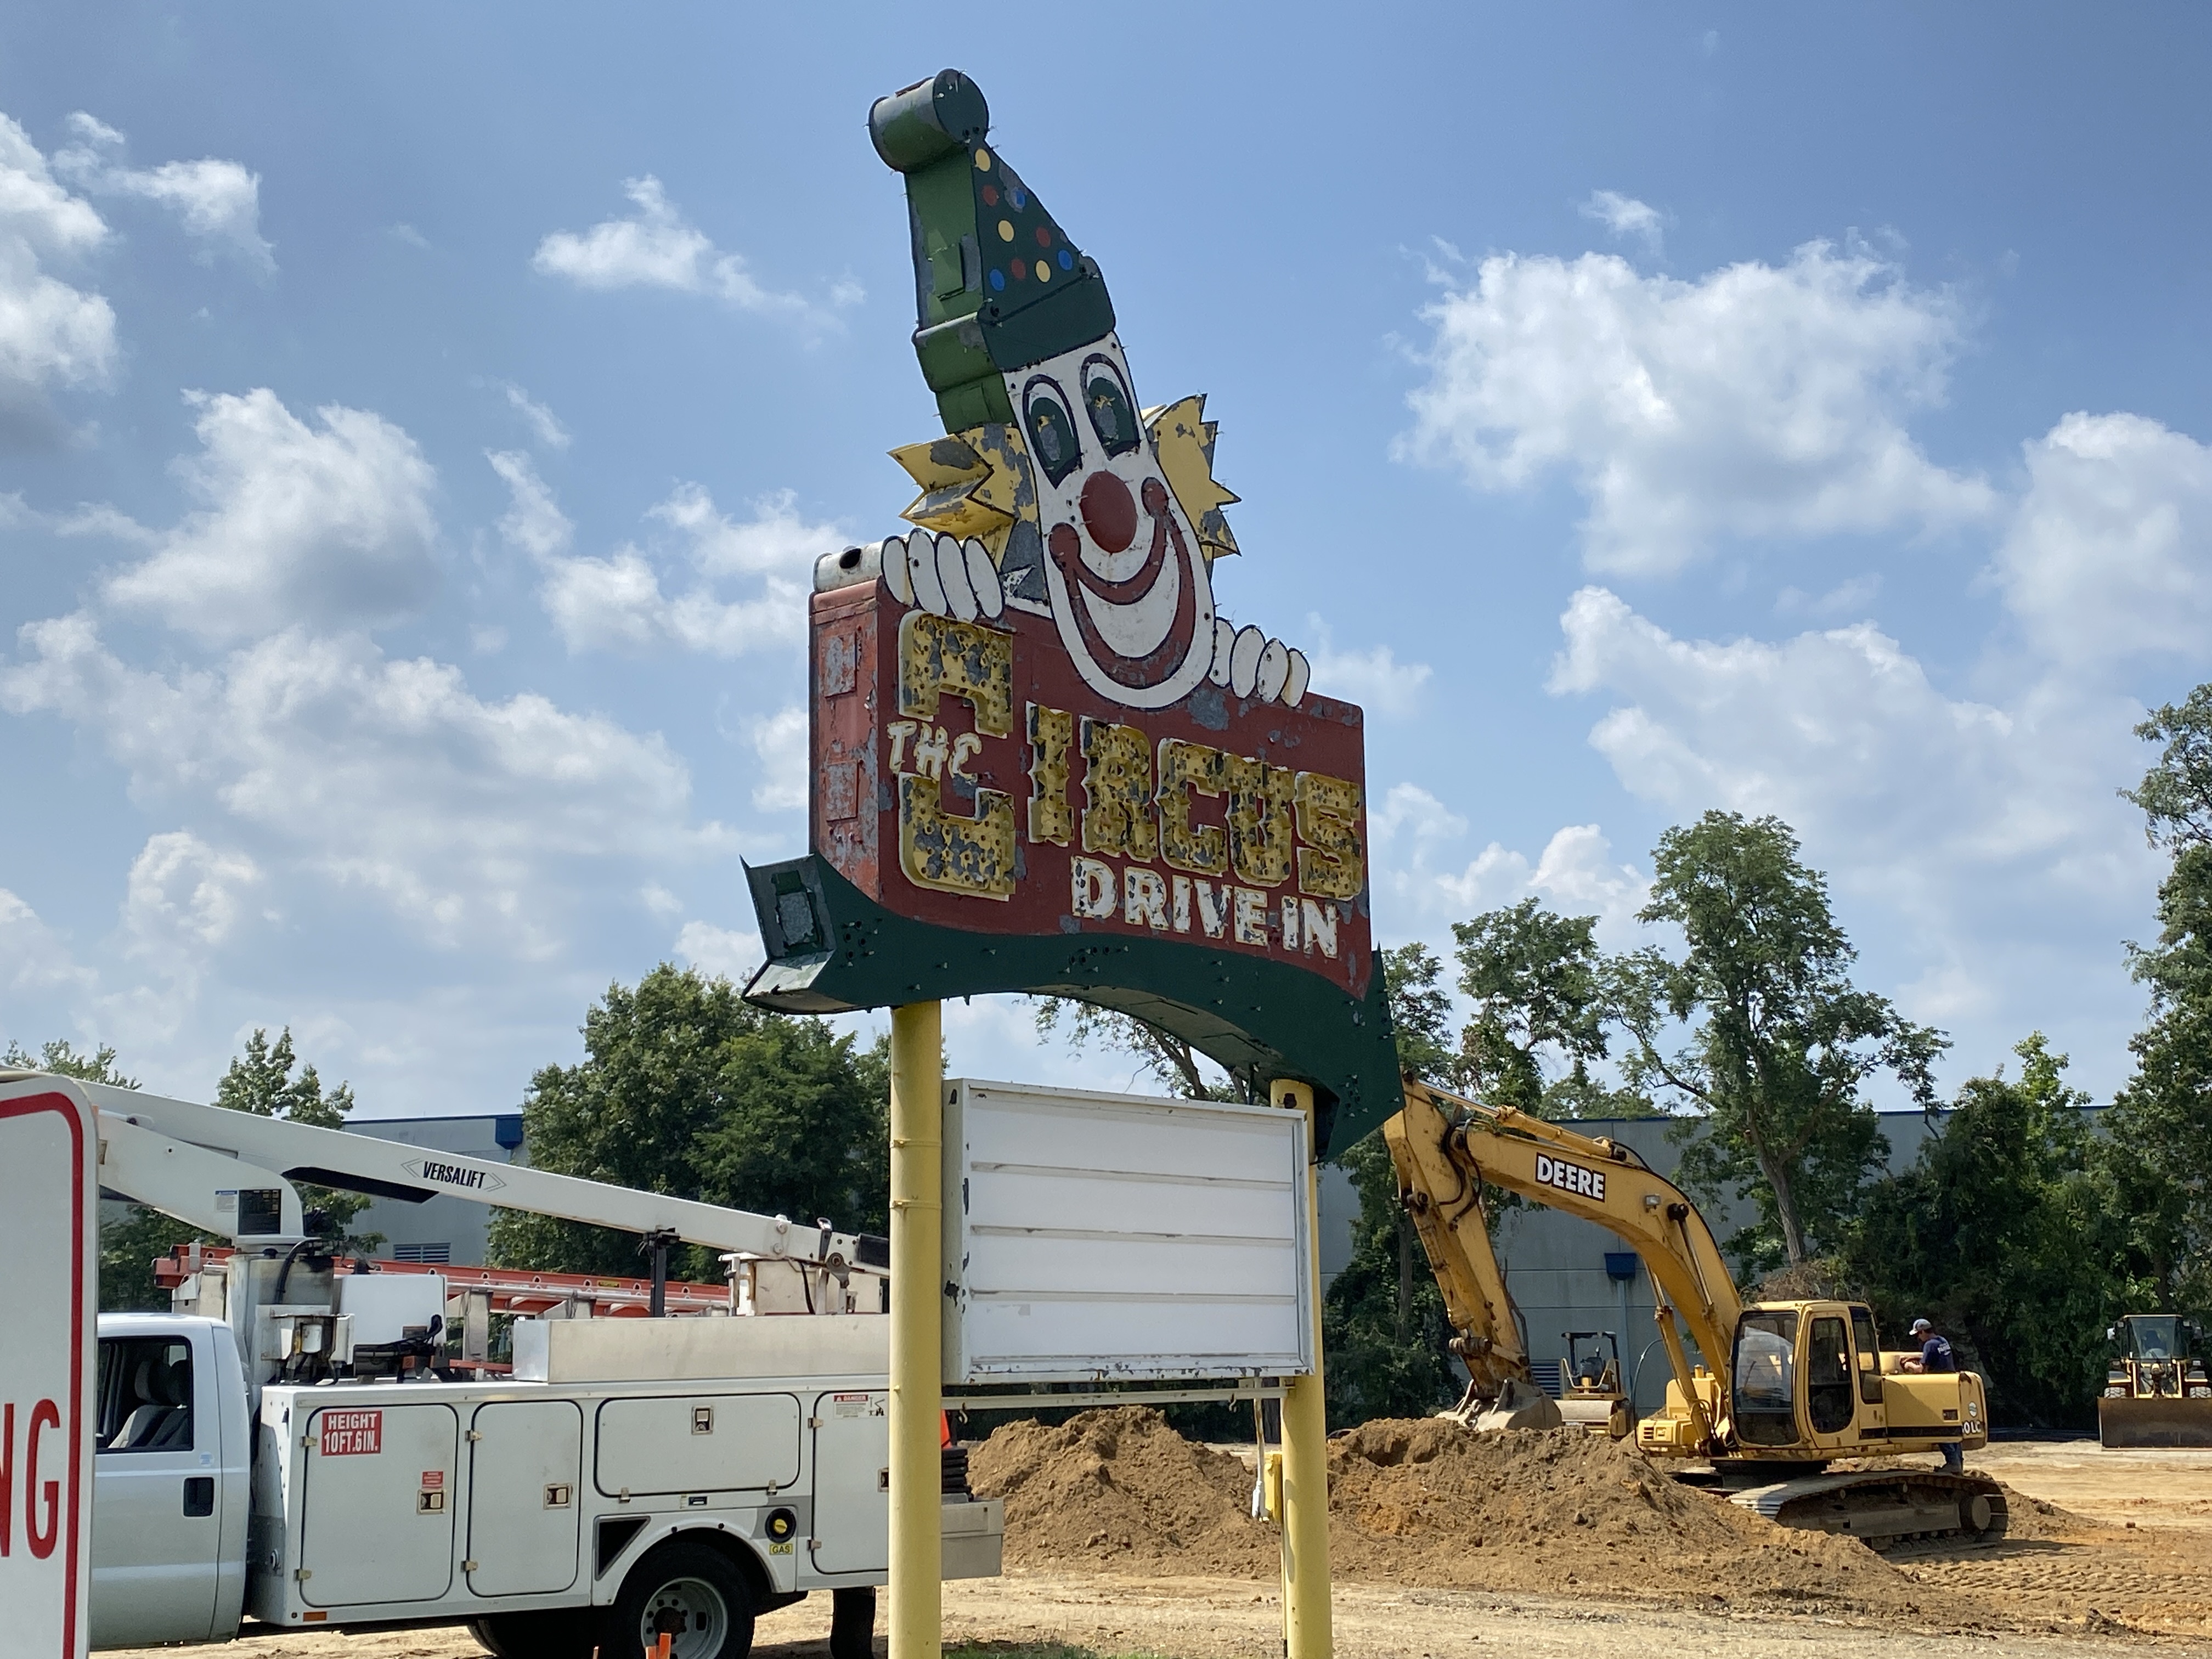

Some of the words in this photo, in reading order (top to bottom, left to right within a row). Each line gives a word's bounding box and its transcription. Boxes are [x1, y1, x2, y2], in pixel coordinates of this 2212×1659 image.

[899, 610, 1363, 902] CIRCUS
[423, 1160, 486, 1189] VERSALIFT
[1537, 1154, 1605, 1200] DEERE
[328, 1413, 377, 1430] HEIGHT
[772, 1545, 791, 1554] GAS
